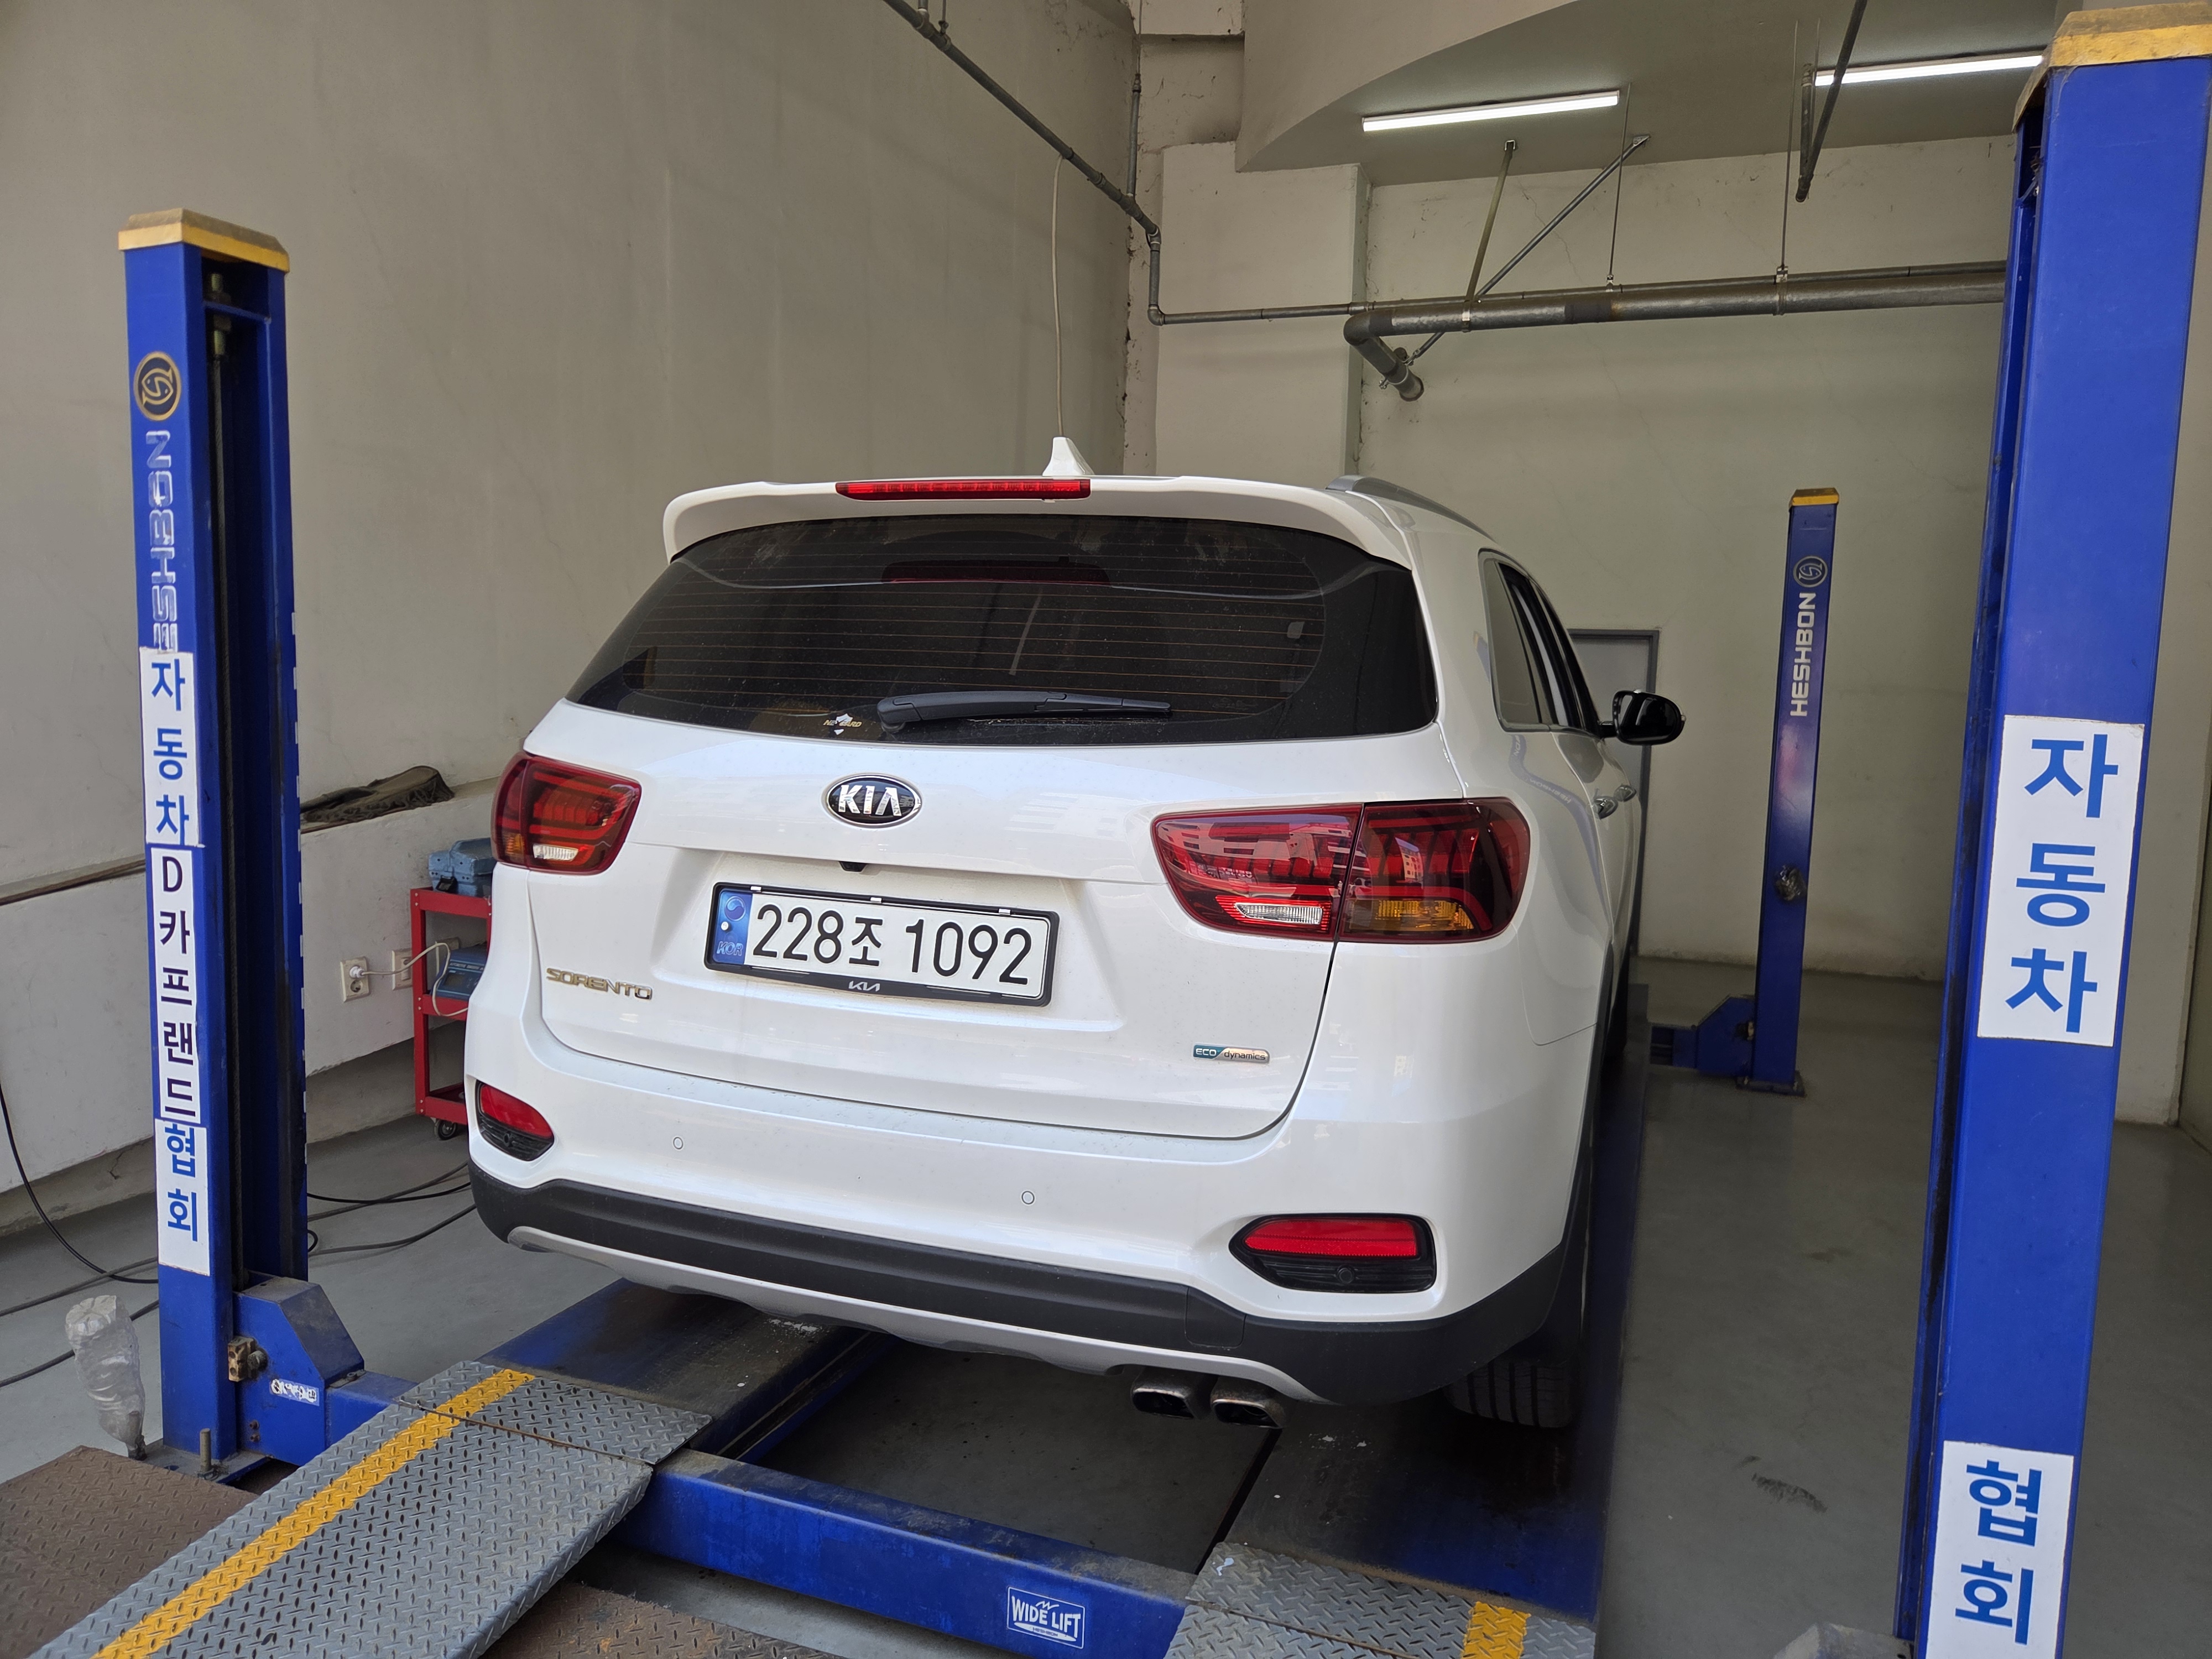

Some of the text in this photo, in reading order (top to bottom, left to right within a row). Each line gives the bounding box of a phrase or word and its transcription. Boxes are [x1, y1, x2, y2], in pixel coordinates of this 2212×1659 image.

[146, 430, 179, 652] ESHBON
[1790, 592, 1816, 717] HESHBON
[838, 784, 902, 817] KIA
[2005, 733, 2119, 1034] 자동차
[151, 658, 199, 1242] 자동차 D카프랜드 협회
[546, 968, 653, 1000] SORENTO
[716, 941, 744, 956] KOR
[753, 904, 1032, 985] 228조 1092
[1196, 1048, 1266, 1061] ECO dynamics
[1955, 1459, 2042, 1646] 협회
[1011, 1595, 1081, 1639] WIDE LIFT
